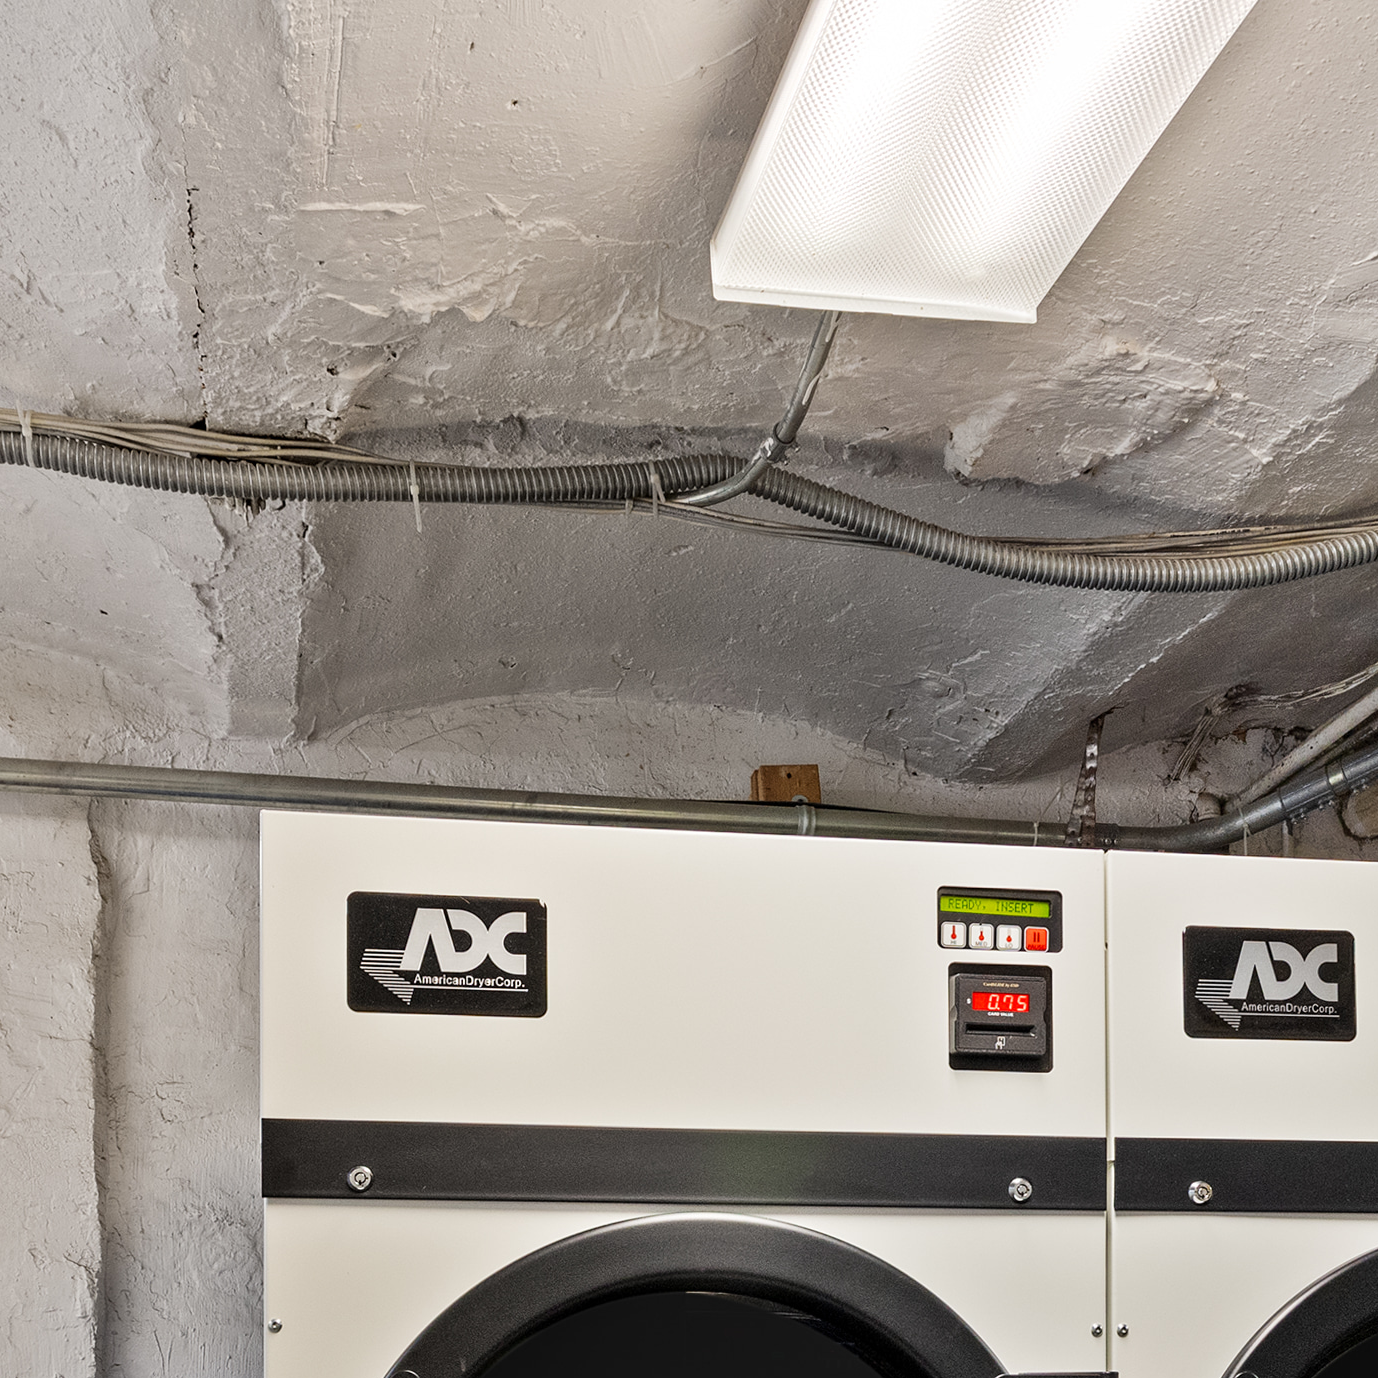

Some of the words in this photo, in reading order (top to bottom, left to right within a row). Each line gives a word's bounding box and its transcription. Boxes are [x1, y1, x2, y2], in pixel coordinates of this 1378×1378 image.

[948, 898, 986, 910] READY,
[996, 901, 1034, 913] INSERT
[400, 908, 527, 975] ADC
[1229, 940, 1338, 1002] ADC
[413, 974, 526, 989] AmericanDryerCorp.
[988, 993, 1027, 1011] 0.75
[1241, 1002, 1337, 1015] AmericanDryerCorp.
